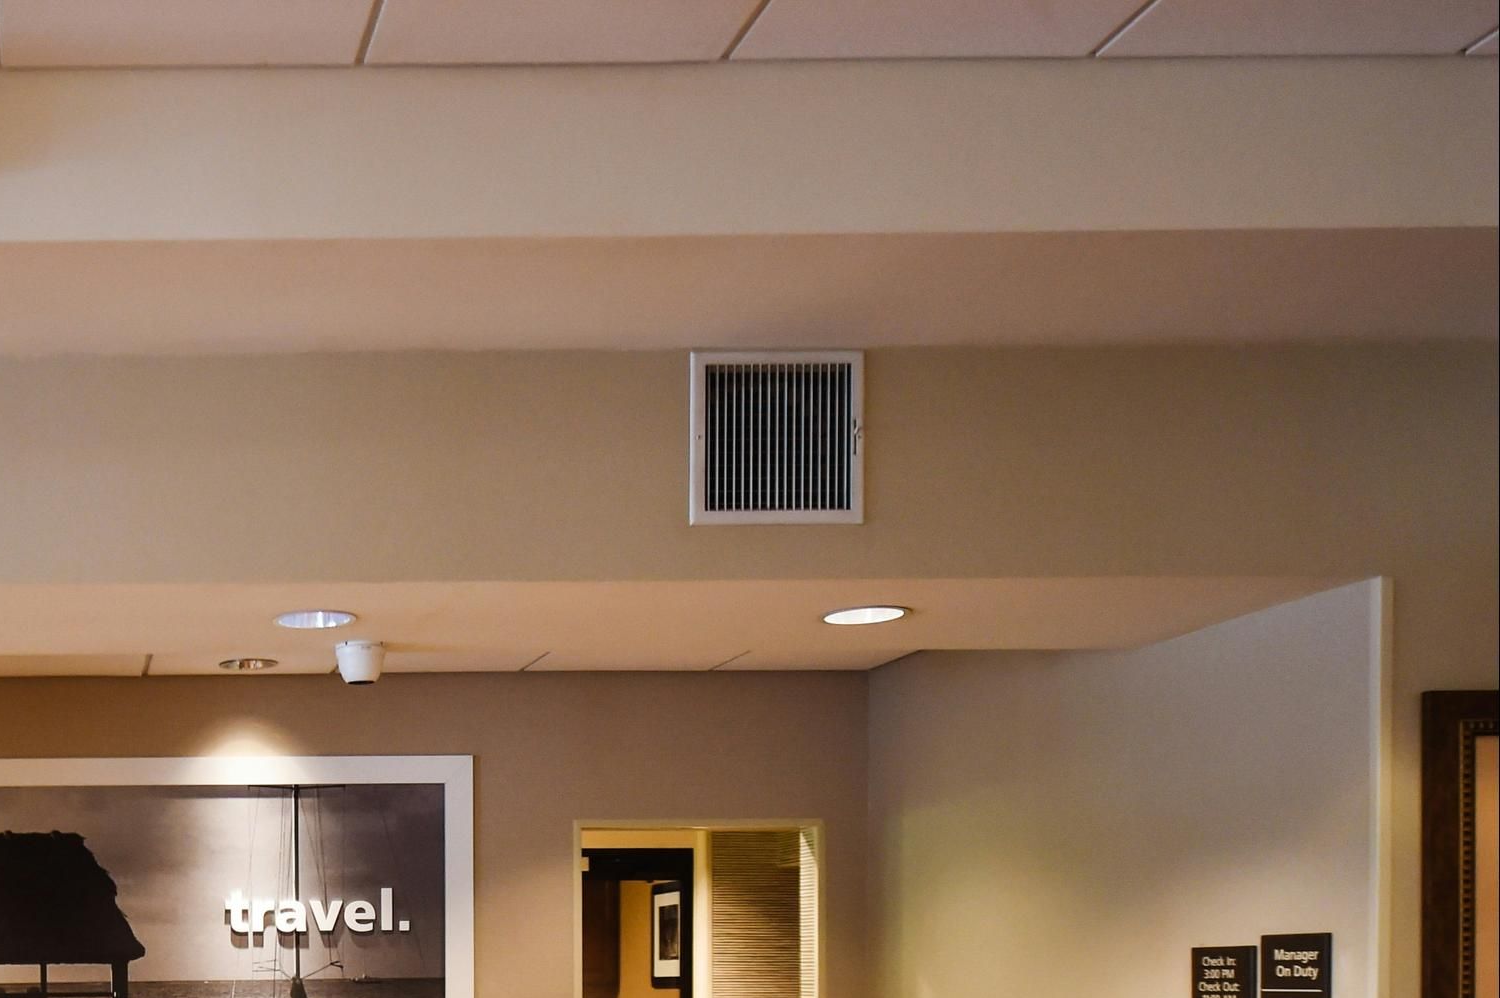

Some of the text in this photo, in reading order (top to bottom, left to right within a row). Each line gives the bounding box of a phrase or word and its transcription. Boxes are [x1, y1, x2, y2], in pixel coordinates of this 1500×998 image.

[224, 887, 411, 934] travel.
[1202, 956, 1225, 967] Check
[1273, 949, 1319, 963] Manager
[1203, 969, 1235, 979] 3:00 PM
[1276, 965, 1319, 980] On Duty
[1198, 981, 1221, 992] Check
